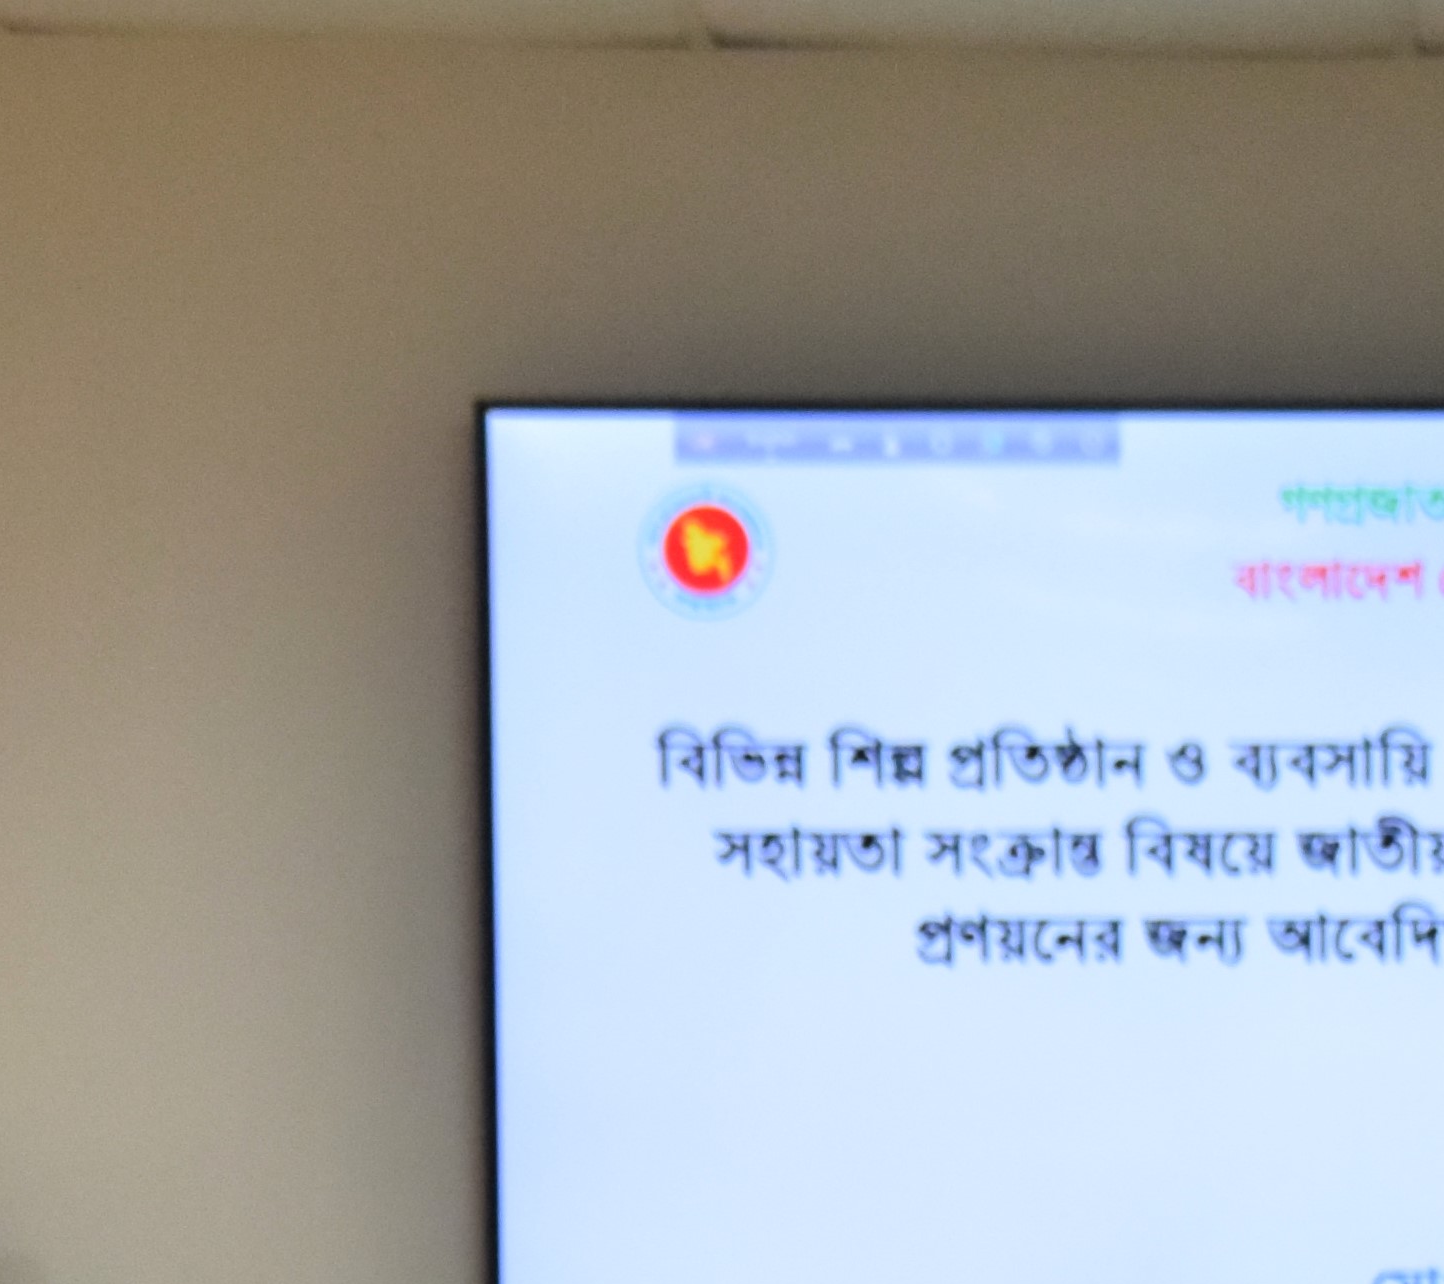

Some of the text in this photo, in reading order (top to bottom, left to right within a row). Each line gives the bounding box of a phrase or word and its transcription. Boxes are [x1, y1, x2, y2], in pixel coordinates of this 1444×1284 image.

[1236, 558, 1424, 600] বাংলাদেশ
[656, 726, 808, 788] বিভিন্ন
[827, 726, 927, 788] শিল্প
[949, 725, 1145, 791] প্রতিষ্ঠান
[1167, 741, 1207, 786] ও
[1232, 726, 1432, 791] ব্যবসায়ি
[713, 823, 905, 880] সহায়তা
[923, 825, 1104, 880] সংক্রান্ত
[1123, 814, 1278, 877] বিষয়ে
[916, 912, 1125, 967] প্রণয়নের
[1142, 917, 1247, 966] জন্য
